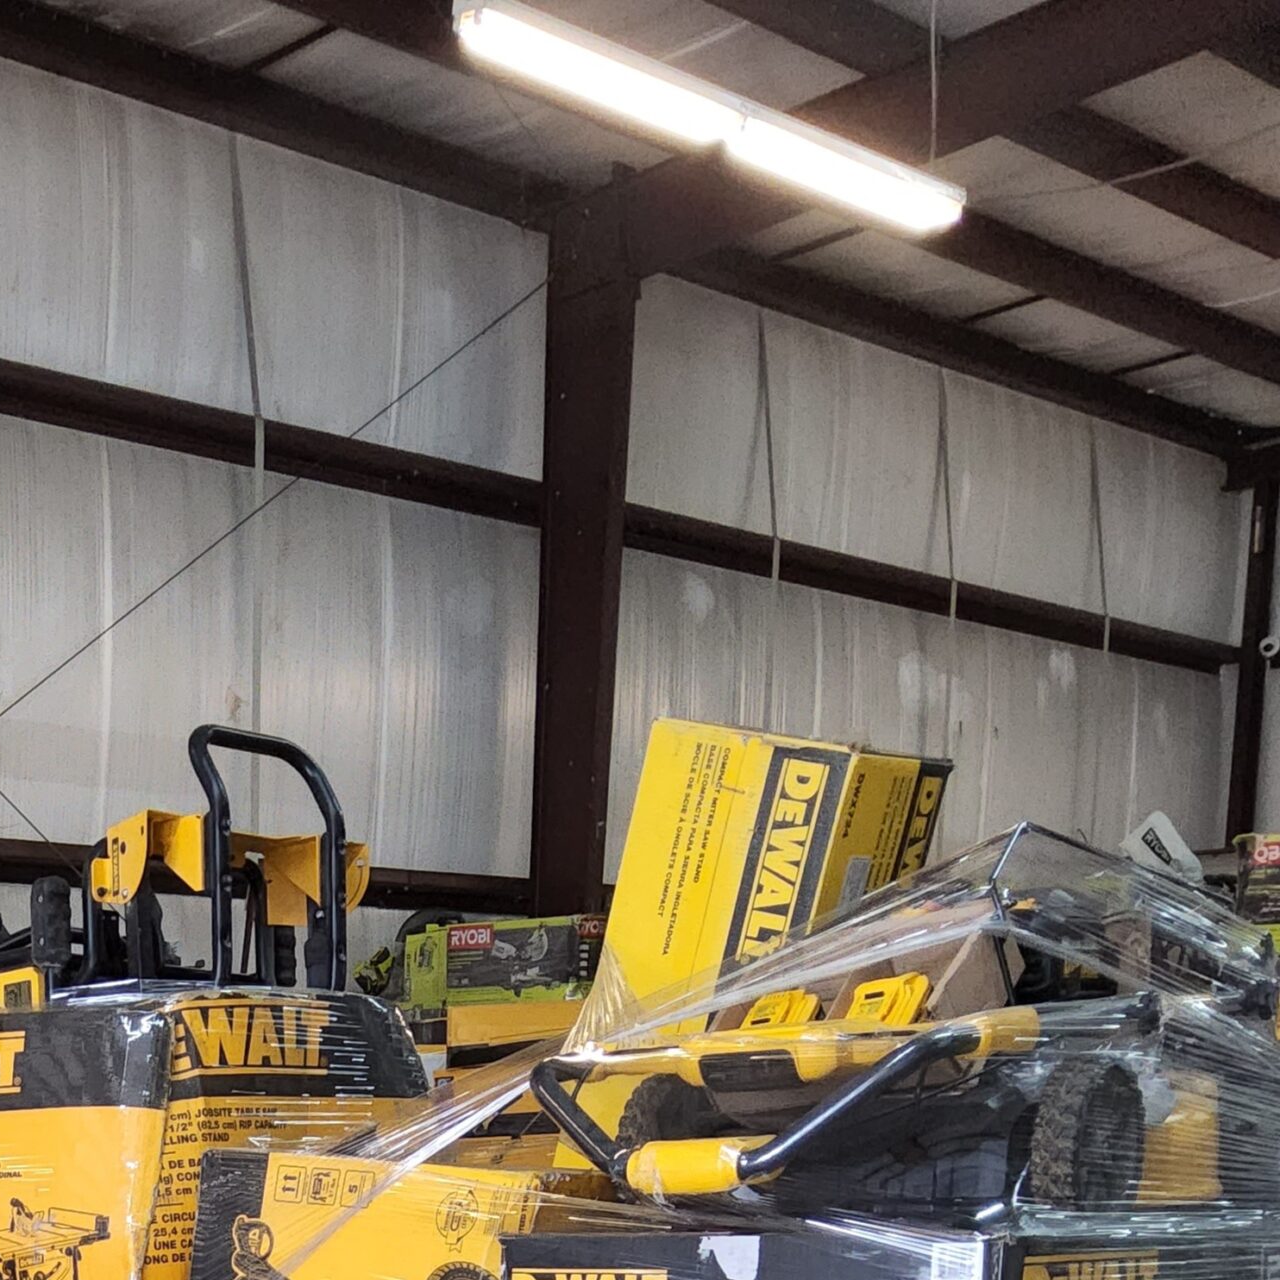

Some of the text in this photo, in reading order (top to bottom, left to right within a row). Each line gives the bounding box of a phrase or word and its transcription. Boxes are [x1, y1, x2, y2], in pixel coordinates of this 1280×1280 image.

[741, 758, 825, 956] DEWALT
[693, 853, 705, 883] STAND
[658, 872, 673, 918] COMPACT
[451, 931, 491, 946] RYOBI
[173, 1007, 330, 1072] EWALT
[170, 1111, 191, 1121] cm)
[239, 1120, 252, 1129] RIP
[202, 1133, 230, 1142] STAND
[169, 1160, 184, 1169] DE
[177, 1172, 200, 1181] CON
[176, 1187, 192, 1195] cm
[153, 1227, 178, 1237] 25,4
[154, 1239, 176, 1250] UNE
[172, 1253, 186, 1262] DE
